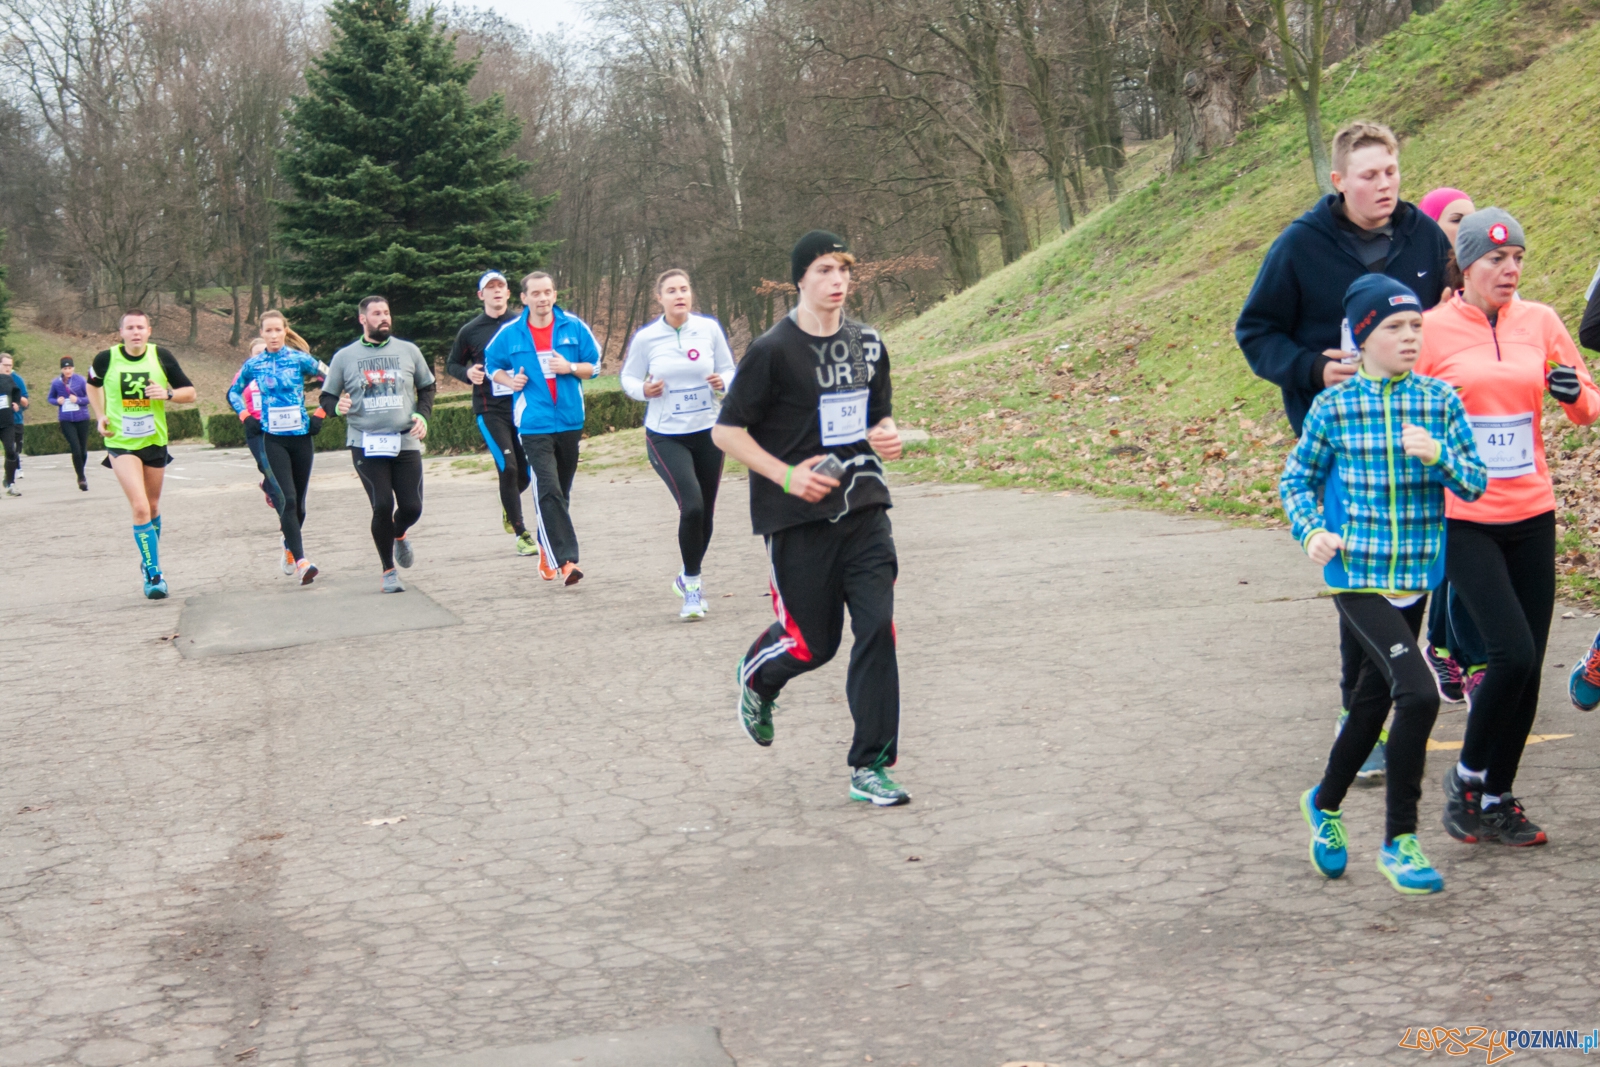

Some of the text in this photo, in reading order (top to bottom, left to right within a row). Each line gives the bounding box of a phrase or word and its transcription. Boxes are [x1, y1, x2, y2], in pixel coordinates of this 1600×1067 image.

[357, 356, 401, 374] POWSTANIE
[683, 394, 698, 402] 841
[841, 405, 857, 417] 524
[1487, 432, 1515, 446] 417
